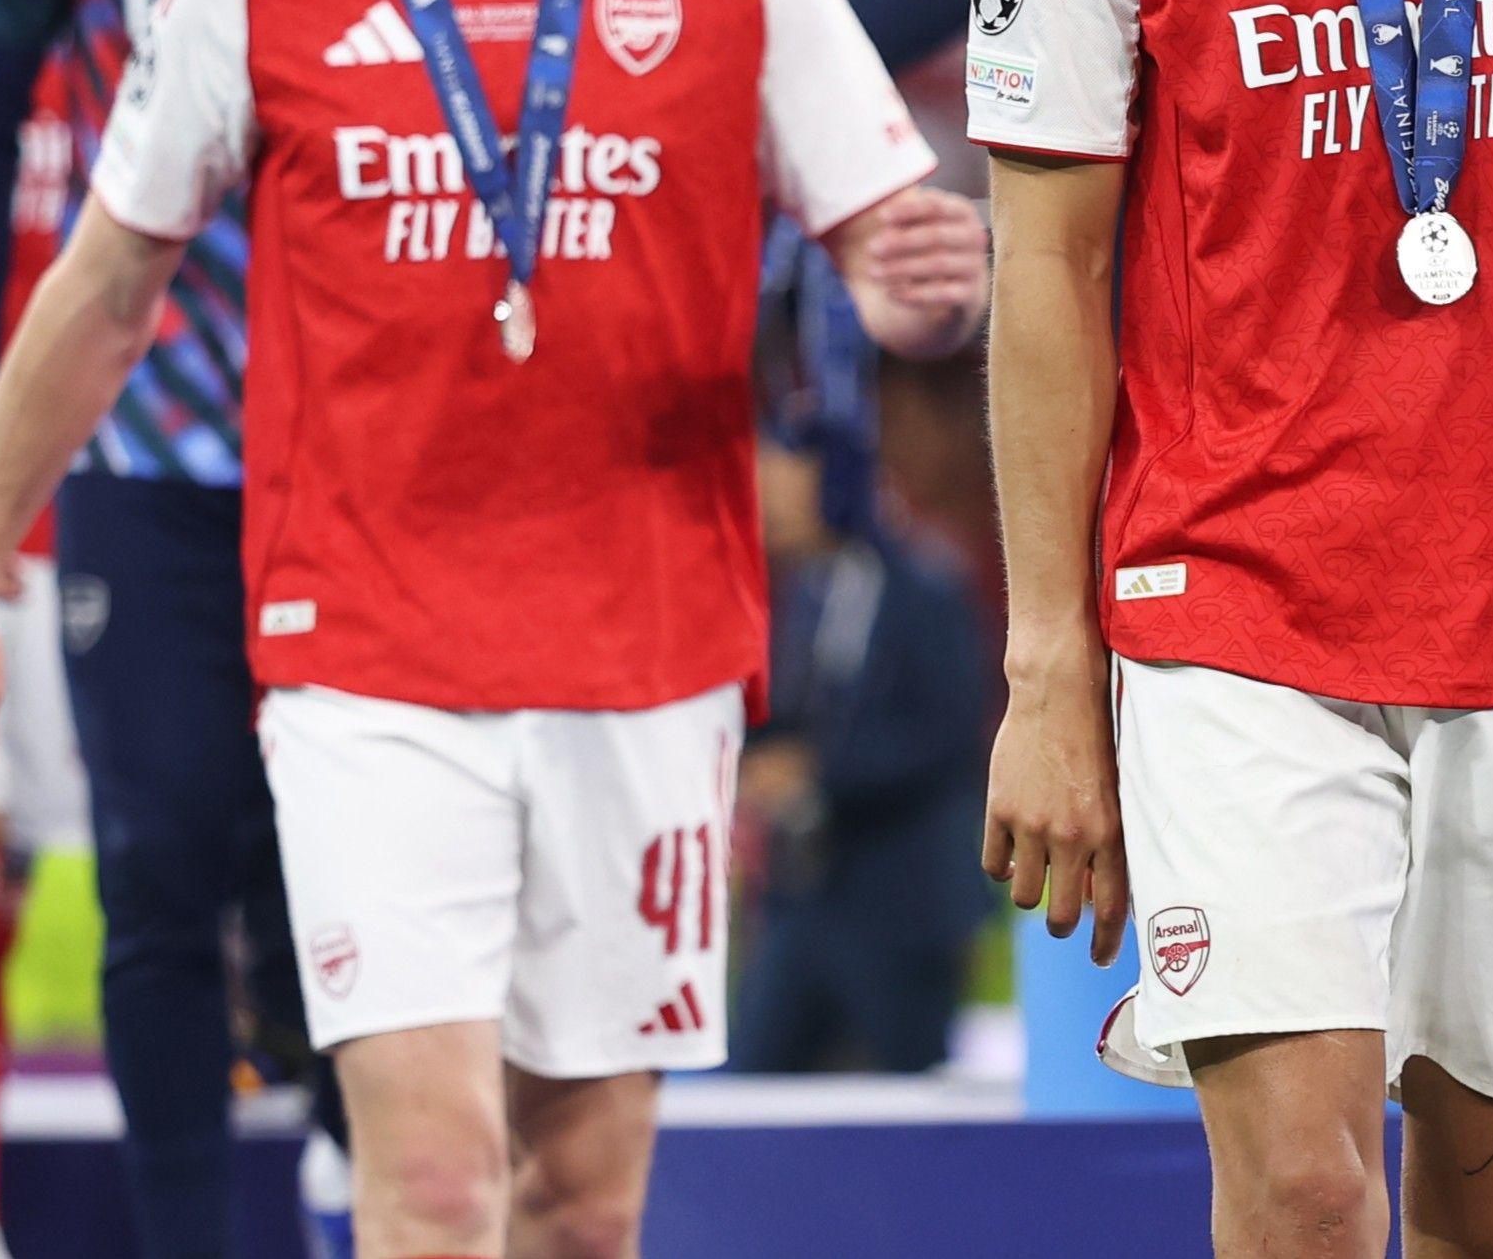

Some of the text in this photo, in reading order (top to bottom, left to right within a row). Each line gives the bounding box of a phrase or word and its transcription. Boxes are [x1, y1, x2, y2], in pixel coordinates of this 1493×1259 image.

[1301, 85, 1371, 159] FLY
[332, 124, 661, 201] Emtes
[384, 197, 616, 263] FLY BTER
[638, 822, 712, 955] 41
[1154, 920, 1199, 939] Arsenal
